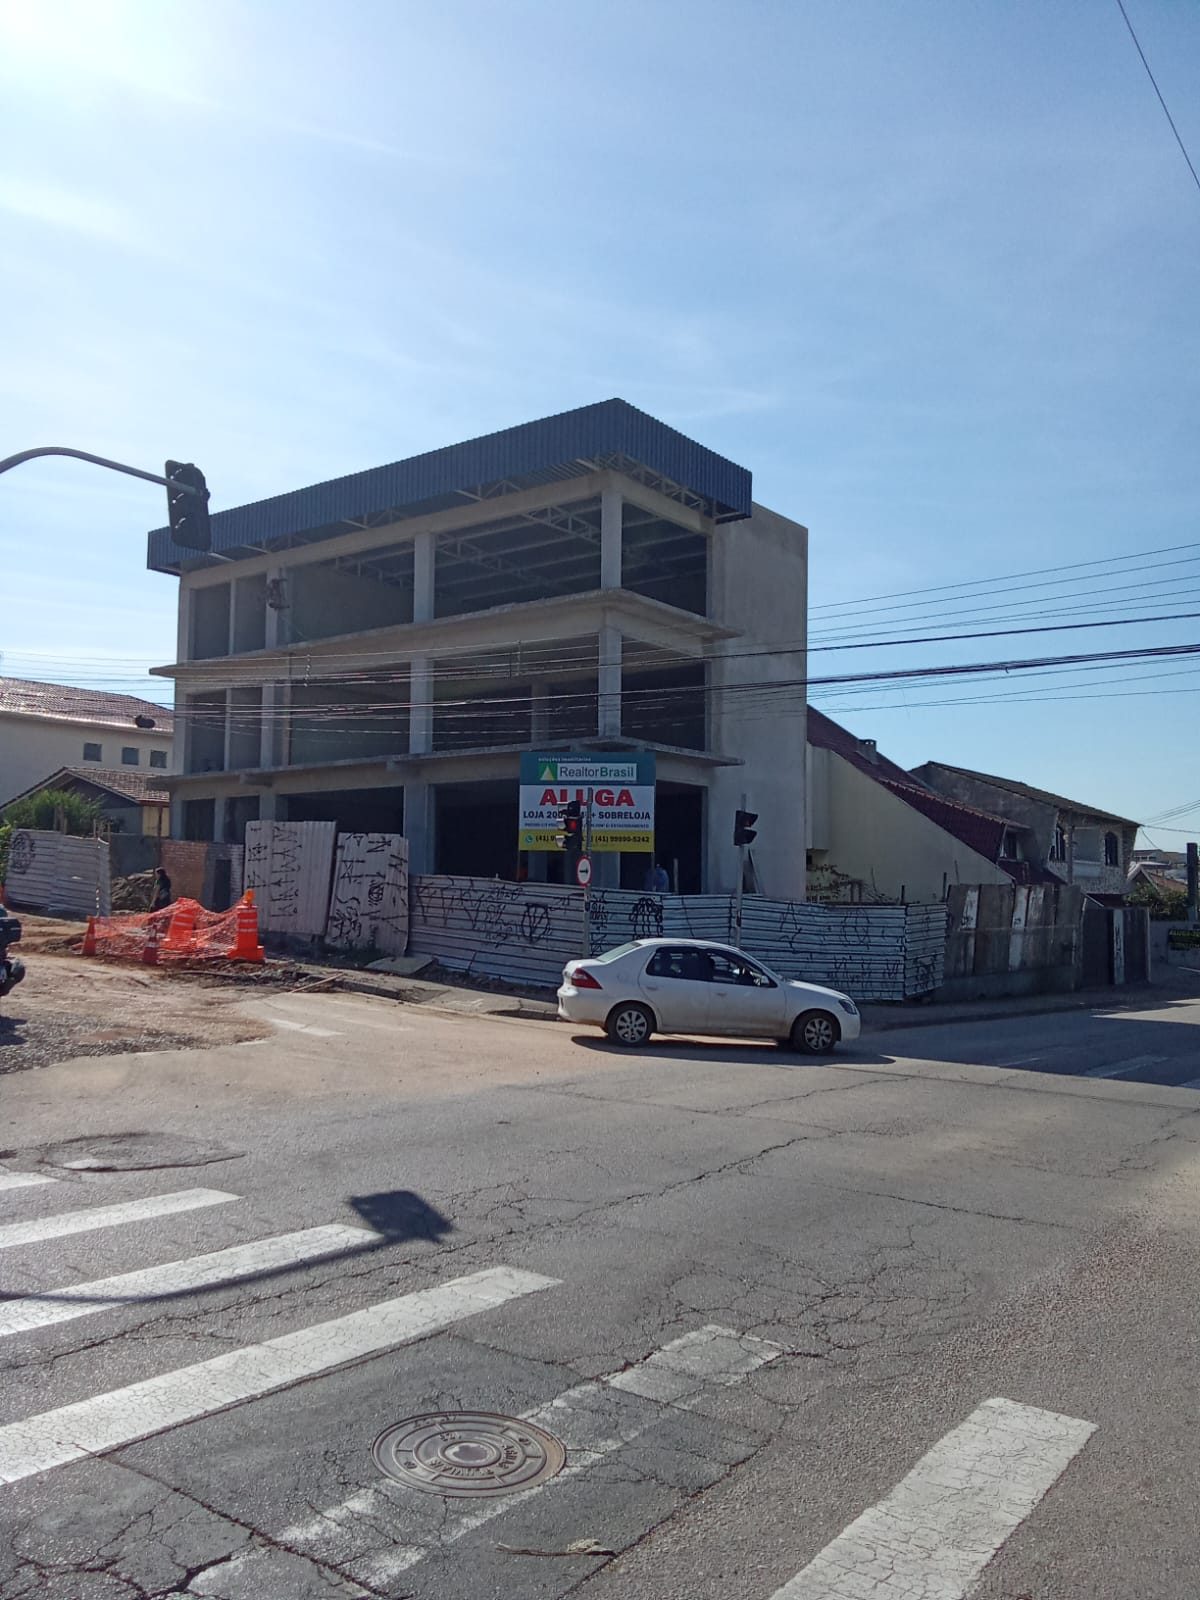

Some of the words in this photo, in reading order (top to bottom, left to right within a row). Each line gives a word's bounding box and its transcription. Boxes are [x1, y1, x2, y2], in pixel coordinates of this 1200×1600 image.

[560, 766, 634, 778] RealtorBrasil
[523, 811, 544, 819] LOJA
[598, 811, 651, 820] SOBRELOJA
[595, 836, 609, 844] (41)
